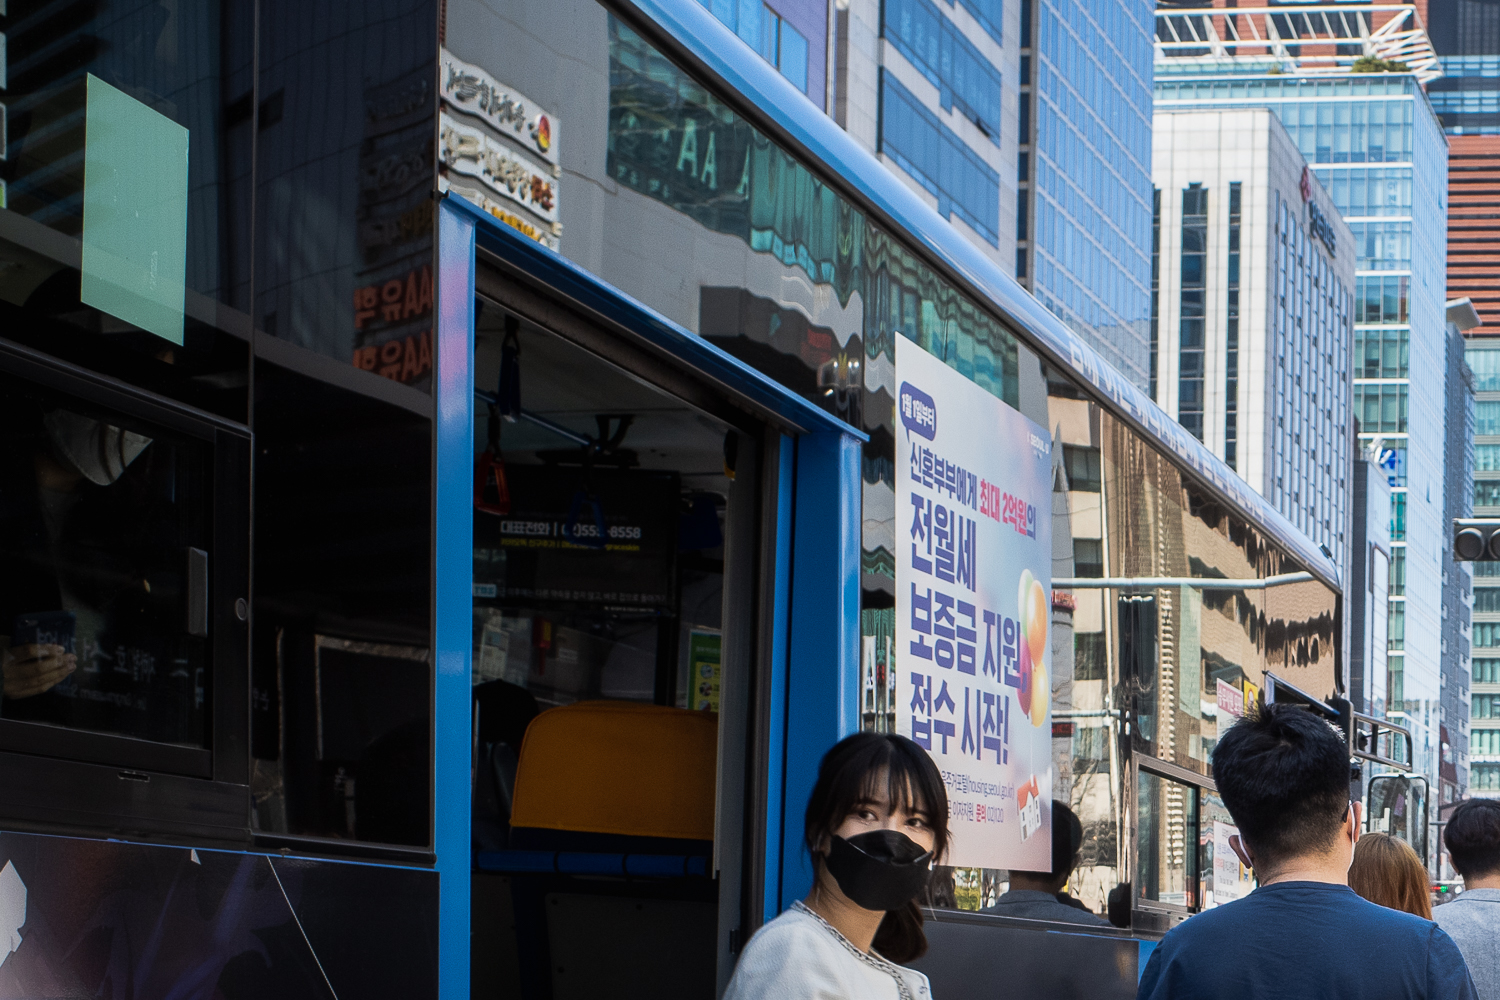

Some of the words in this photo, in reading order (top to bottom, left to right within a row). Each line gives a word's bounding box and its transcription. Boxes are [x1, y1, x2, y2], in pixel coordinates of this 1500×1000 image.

[901, 393, 912, 419] 1월
[912, 398, 935, 432] 1일부터
[910, 442, 977, 511] 신혼부부에게
[980, 478, 1000, 523] 최대
[1002, 491, 1036, 541] 2억원의
[910, 492, 976, 593] 전월세
[910, 582, 977, 676] 보증금
[983, 609, 1027, 693] 지원,
[910, 672, 955, 755] 접수
[961, 686, 1010, 765] 시작!
[976, 803, 986, 823] 문의
